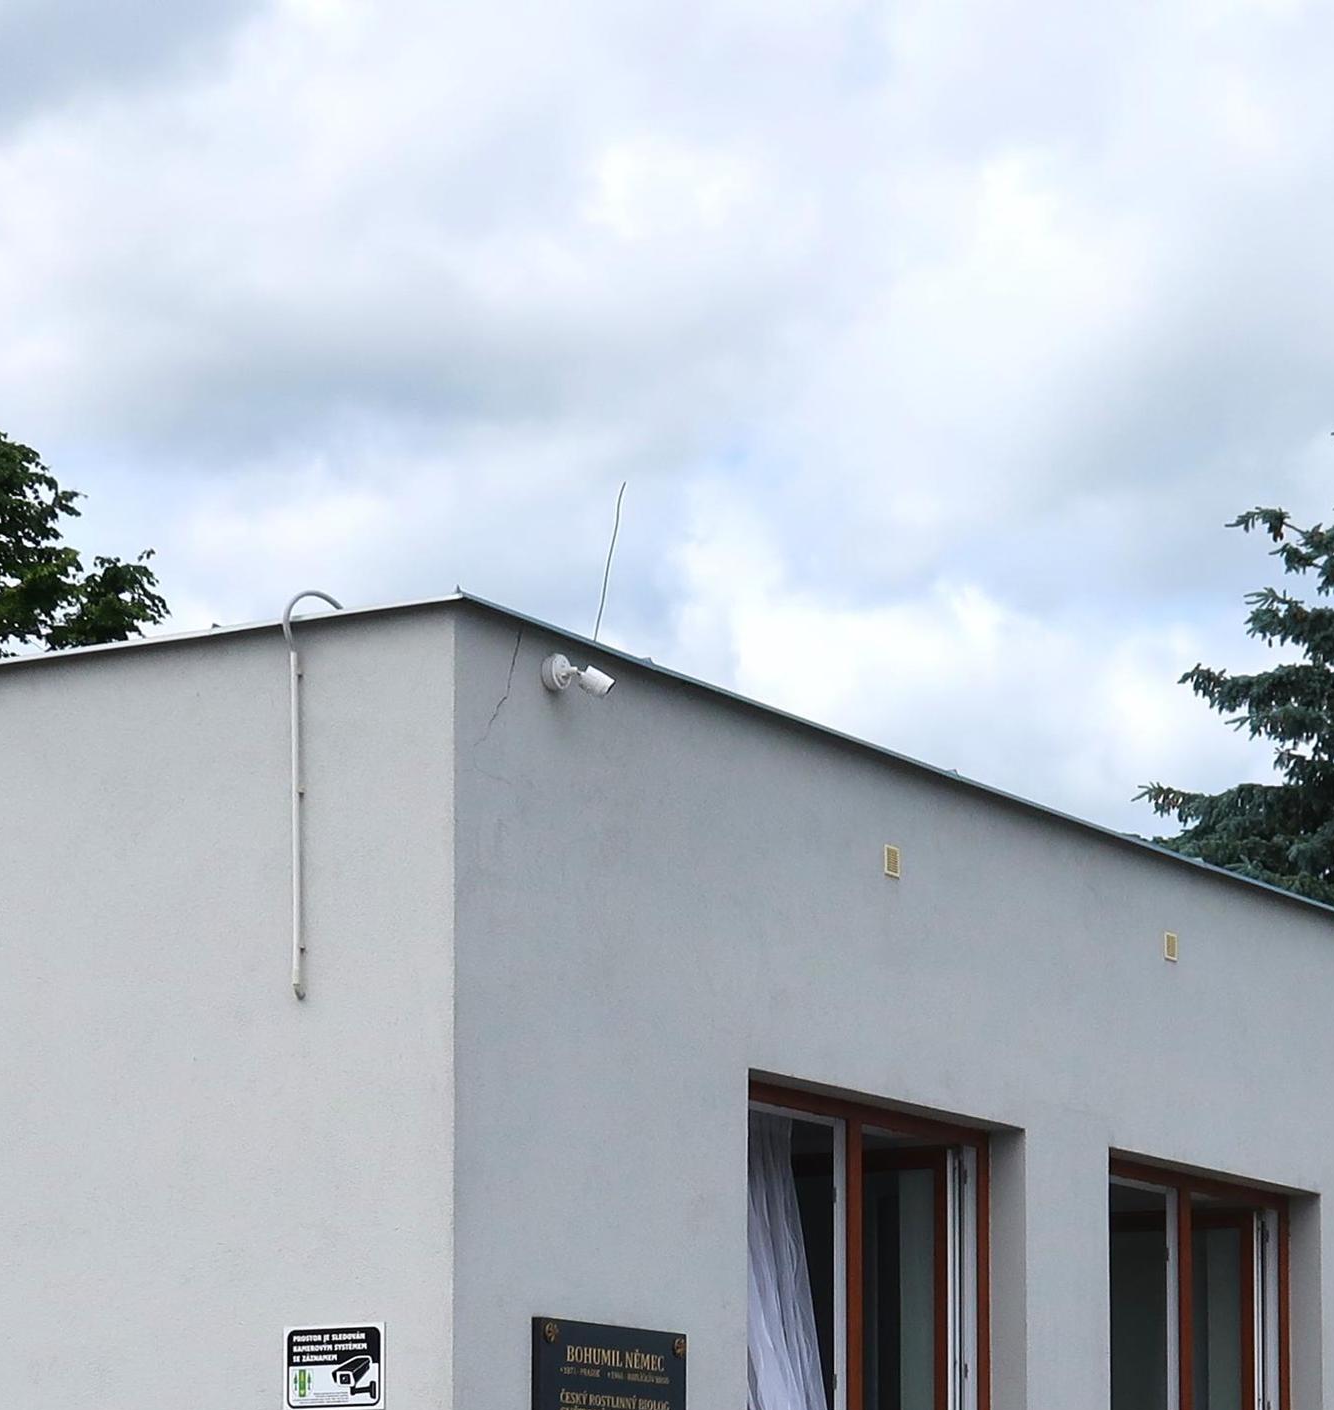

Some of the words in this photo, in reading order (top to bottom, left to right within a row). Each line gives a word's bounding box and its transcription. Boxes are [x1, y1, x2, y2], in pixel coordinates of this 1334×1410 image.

[323, 1334, 330, 1342] JE
[293, 1355, 300, 1363] SE
[566, 1345, 623, 1368] BOHUMIL
[625, 1349, 665, 1372] NĚMEC
[560, 1388, 588, 1405] ČESKÝ
[589, 1393, 637, 1410] ROSTLINNÝ
